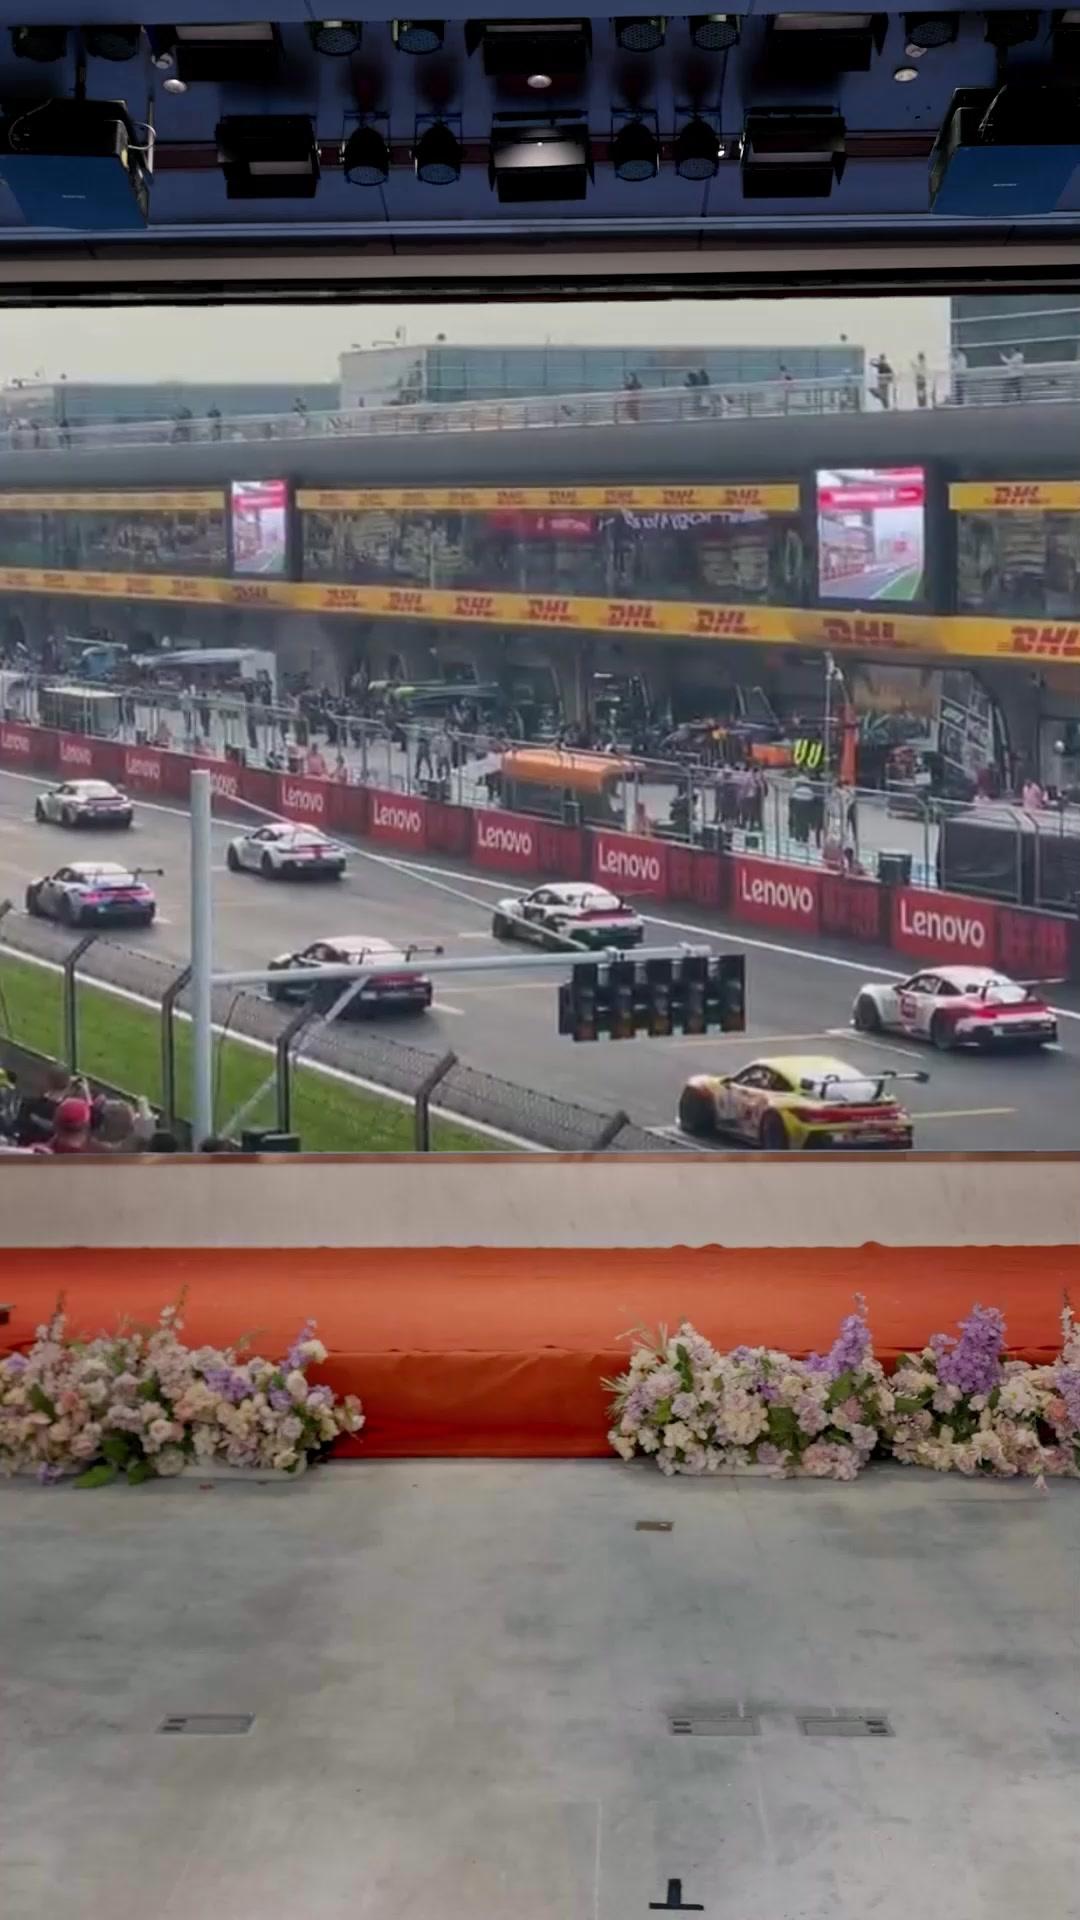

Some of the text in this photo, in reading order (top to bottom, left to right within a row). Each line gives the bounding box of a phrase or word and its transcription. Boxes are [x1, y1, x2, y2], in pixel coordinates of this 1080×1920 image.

[607, 604, 657, 627] DHL
[697, 609, 751, 633] DHL
[823, 618, 898, 648] DHL
[1011, 626, 1080, 656] DHL
[281, 779, 324, 812] Lenovo
[373, 799, 422, 832] Lenovo
[477, 820, 533, 855] Lenovo
[598, 841, 661, 880] Lenovo
[742, 869, 814, 913] Lenovo
[901, 899, 986, 948] Lenovo
